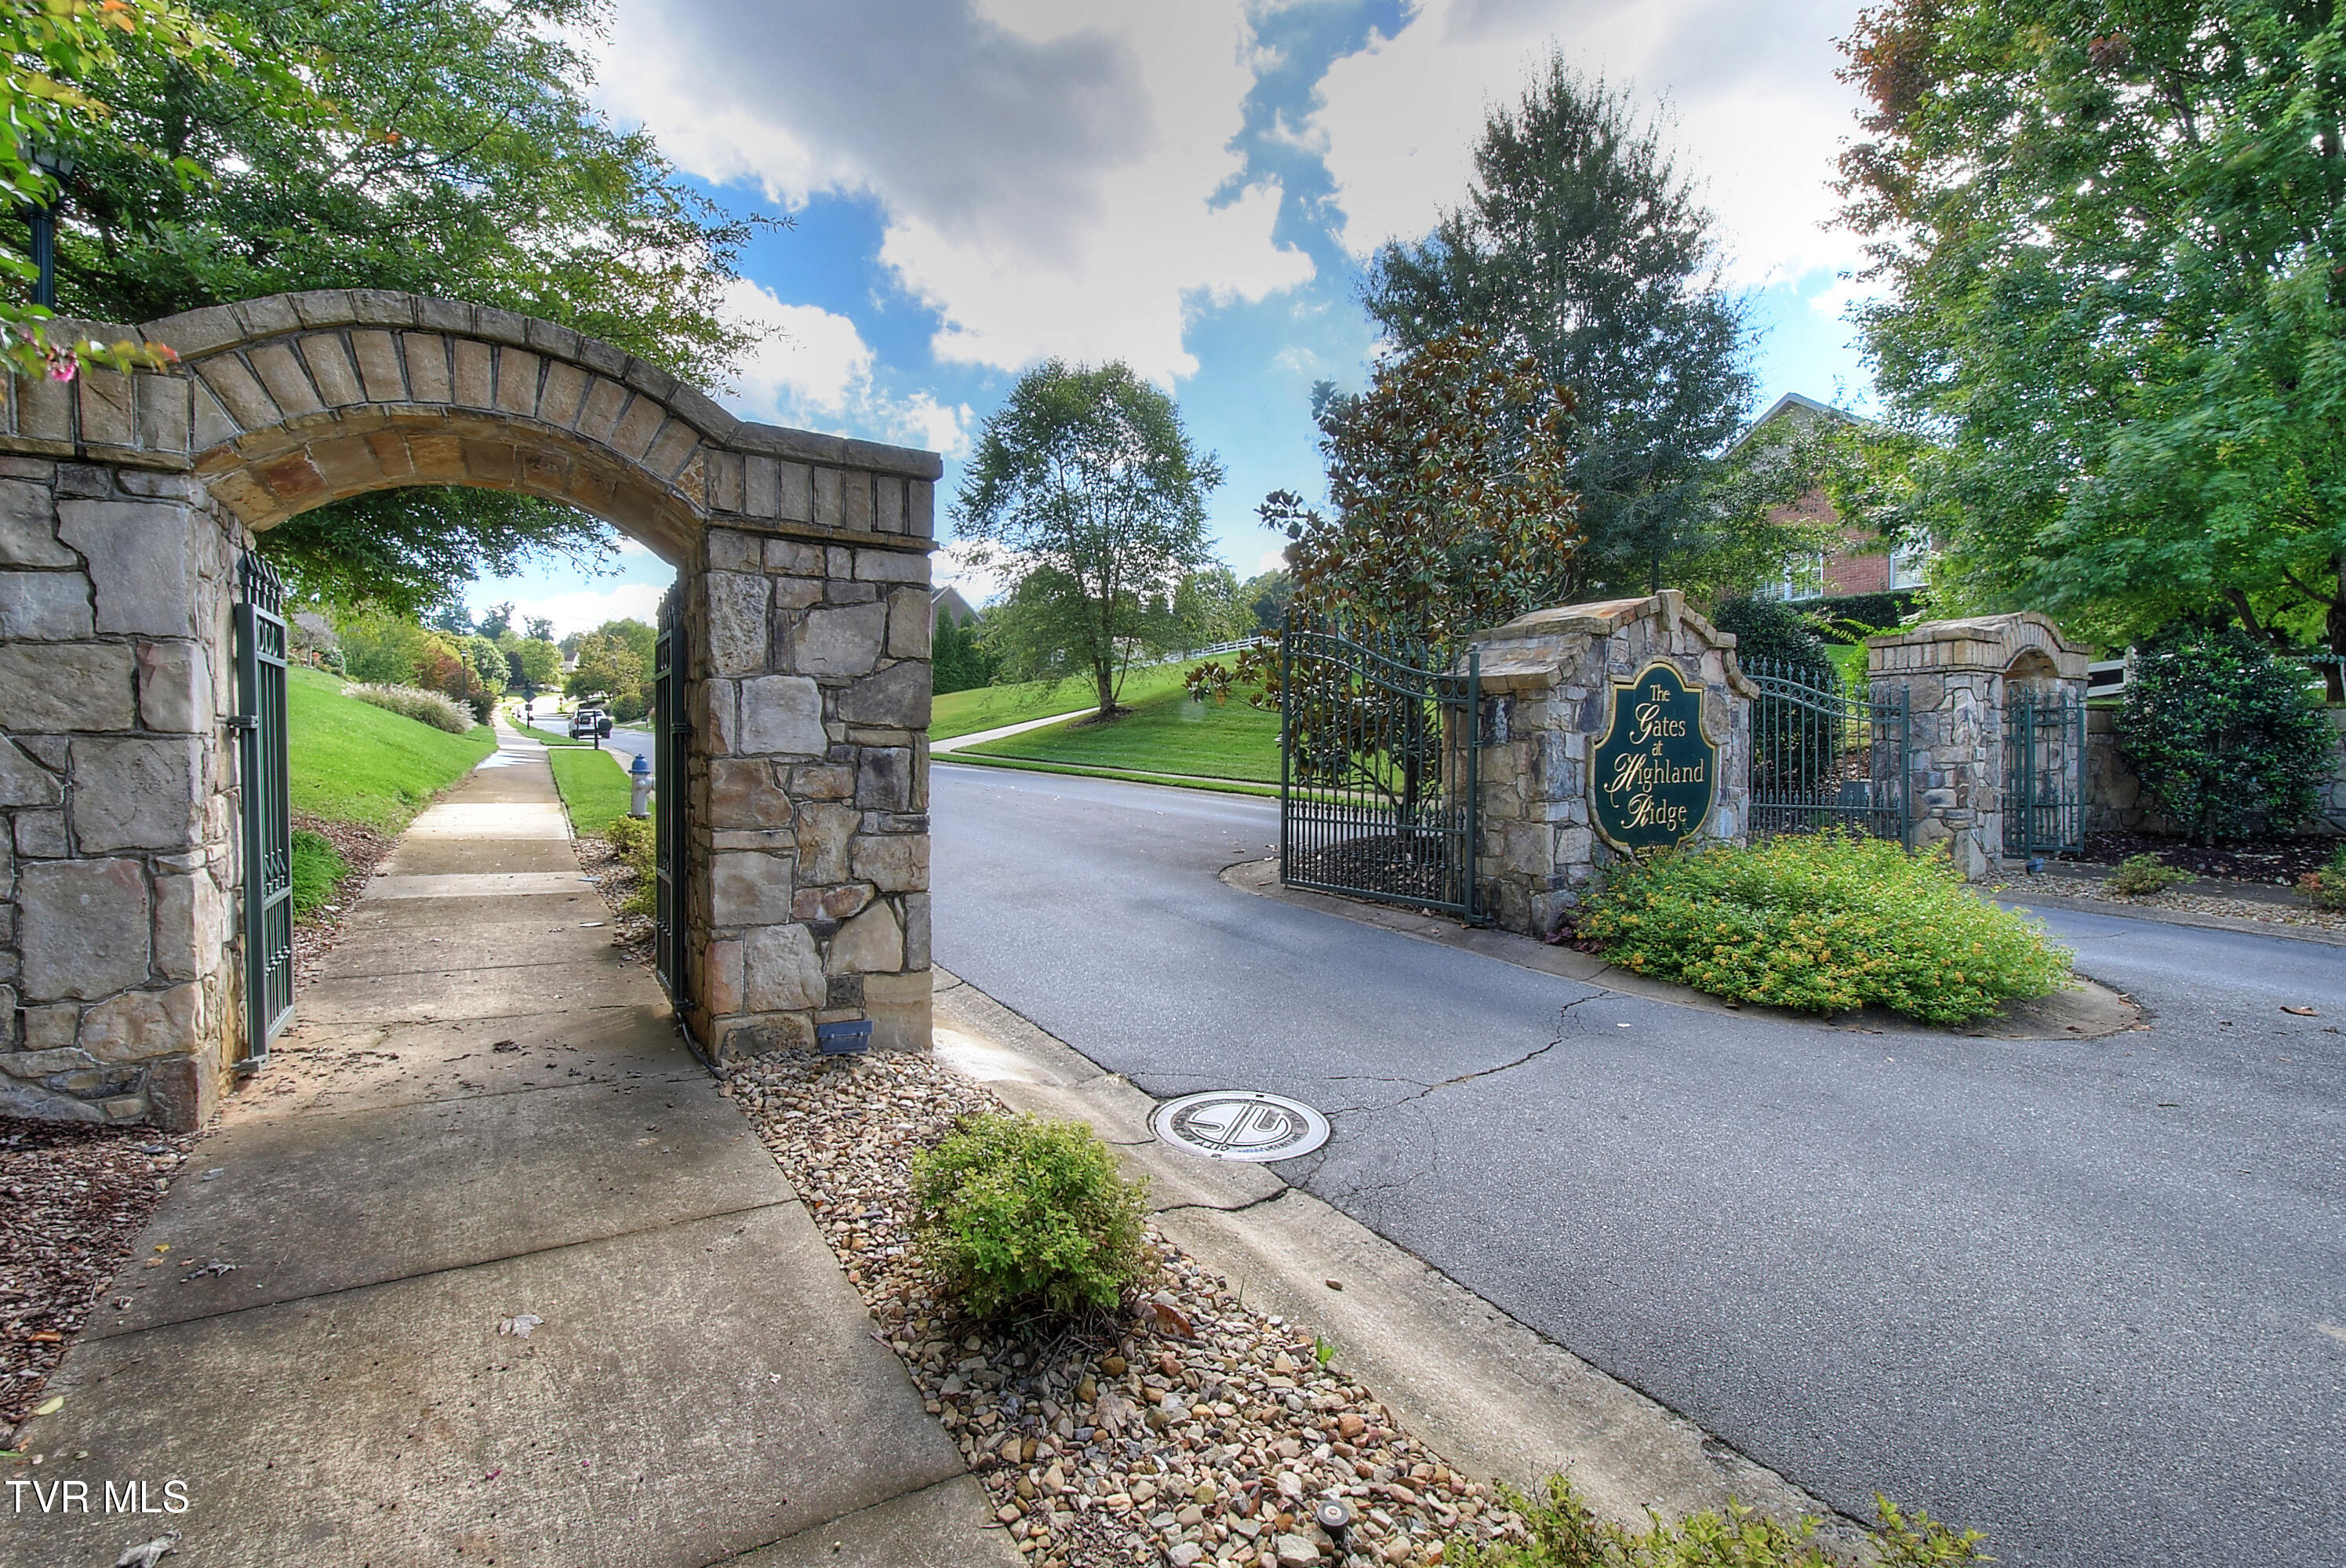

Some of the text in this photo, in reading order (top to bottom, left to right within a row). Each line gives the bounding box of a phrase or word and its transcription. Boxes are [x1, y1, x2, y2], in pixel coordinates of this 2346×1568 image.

[1649, 683, 1671, 702] The
[1629, 703, 1686, 744] Gates
[1651, 740, 1664, 756] at
[1604, 753, 1704, 808] Highland
[1621, 793, 1687, 831] Ridge
